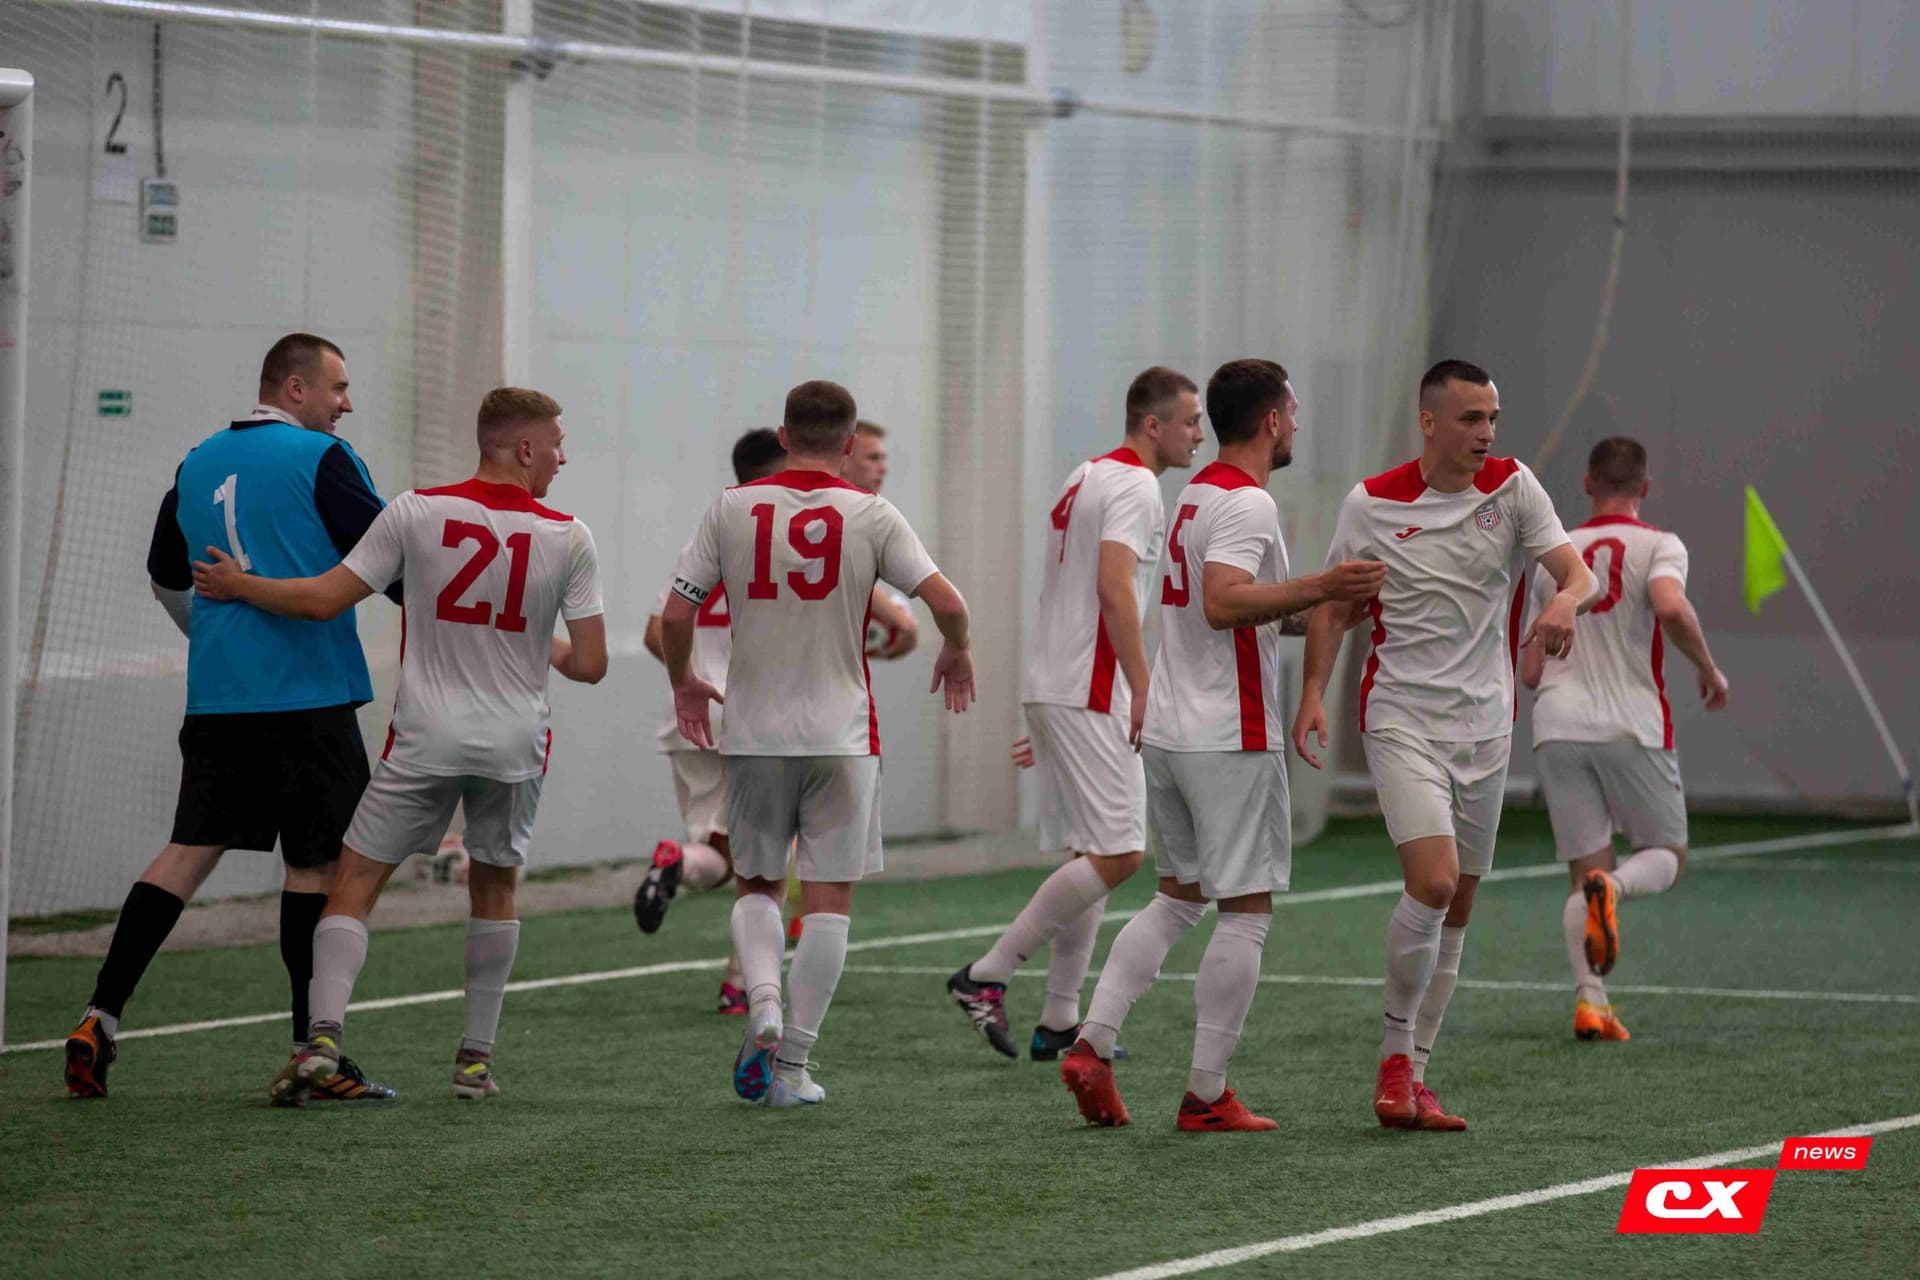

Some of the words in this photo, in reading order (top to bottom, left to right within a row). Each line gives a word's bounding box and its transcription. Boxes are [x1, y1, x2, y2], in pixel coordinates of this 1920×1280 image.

[105, 72, 127, 154] 2
[213, 473, 252, 572] 1
[748, 503, 844, 600] 19
[1161, 503, 1199, 608] 5
[436, 518, 531, 632] 21
